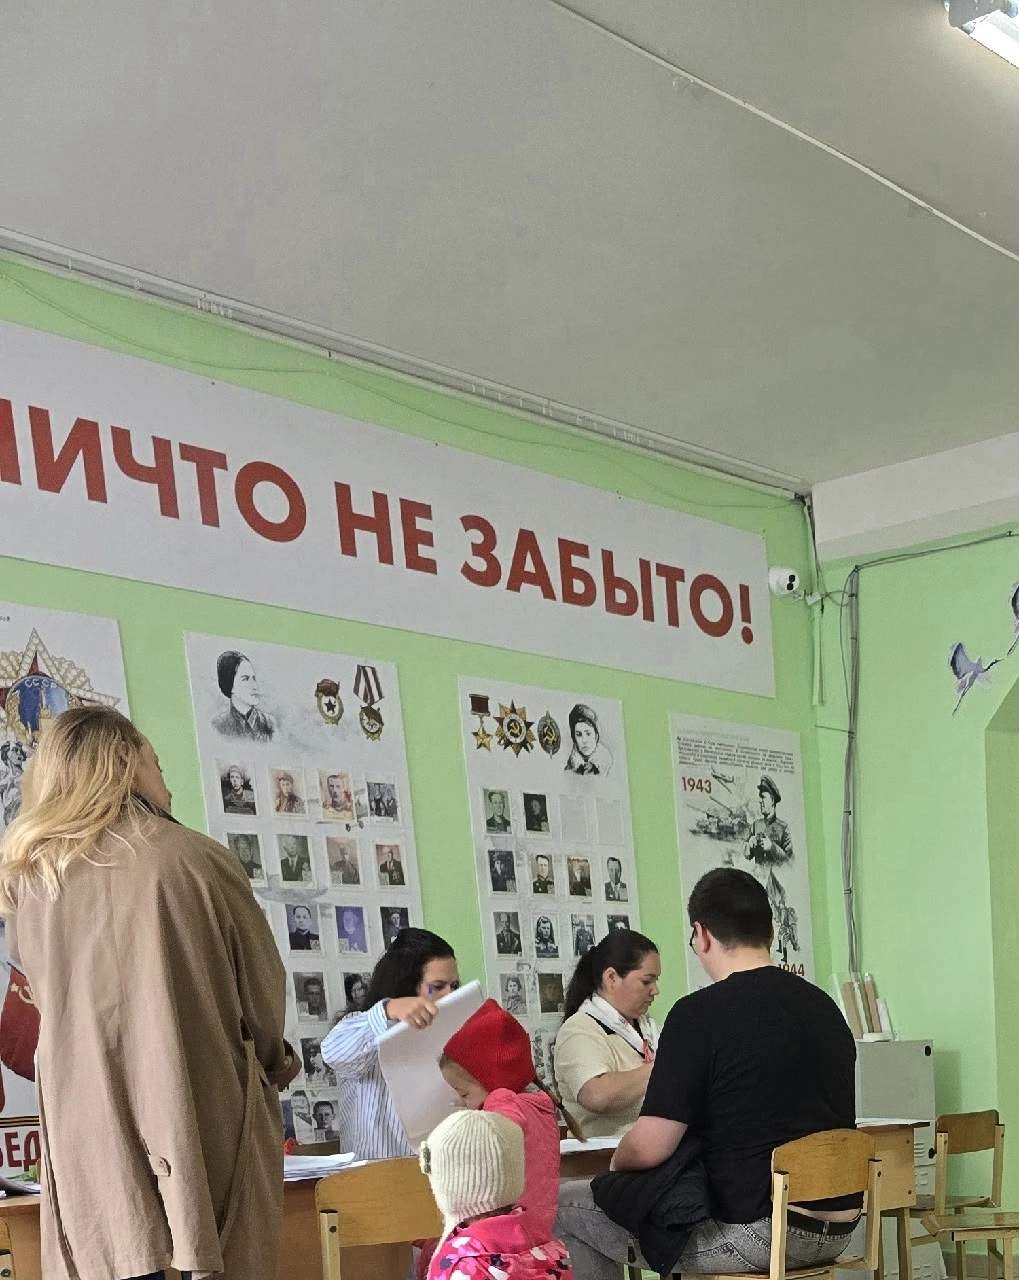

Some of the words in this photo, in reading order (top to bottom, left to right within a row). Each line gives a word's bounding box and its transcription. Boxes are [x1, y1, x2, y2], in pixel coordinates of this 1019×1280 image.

[0, 397, 307, 543] ИЧТО
[334, 480, 438, 576] НЕ
[458, 513, 754, 645] ЗАБЫТО!
[24, 678, 58, 689] СССР
[681, 776, 712, 794] 1943
[0, 1130, 41, 1172] ЕД
